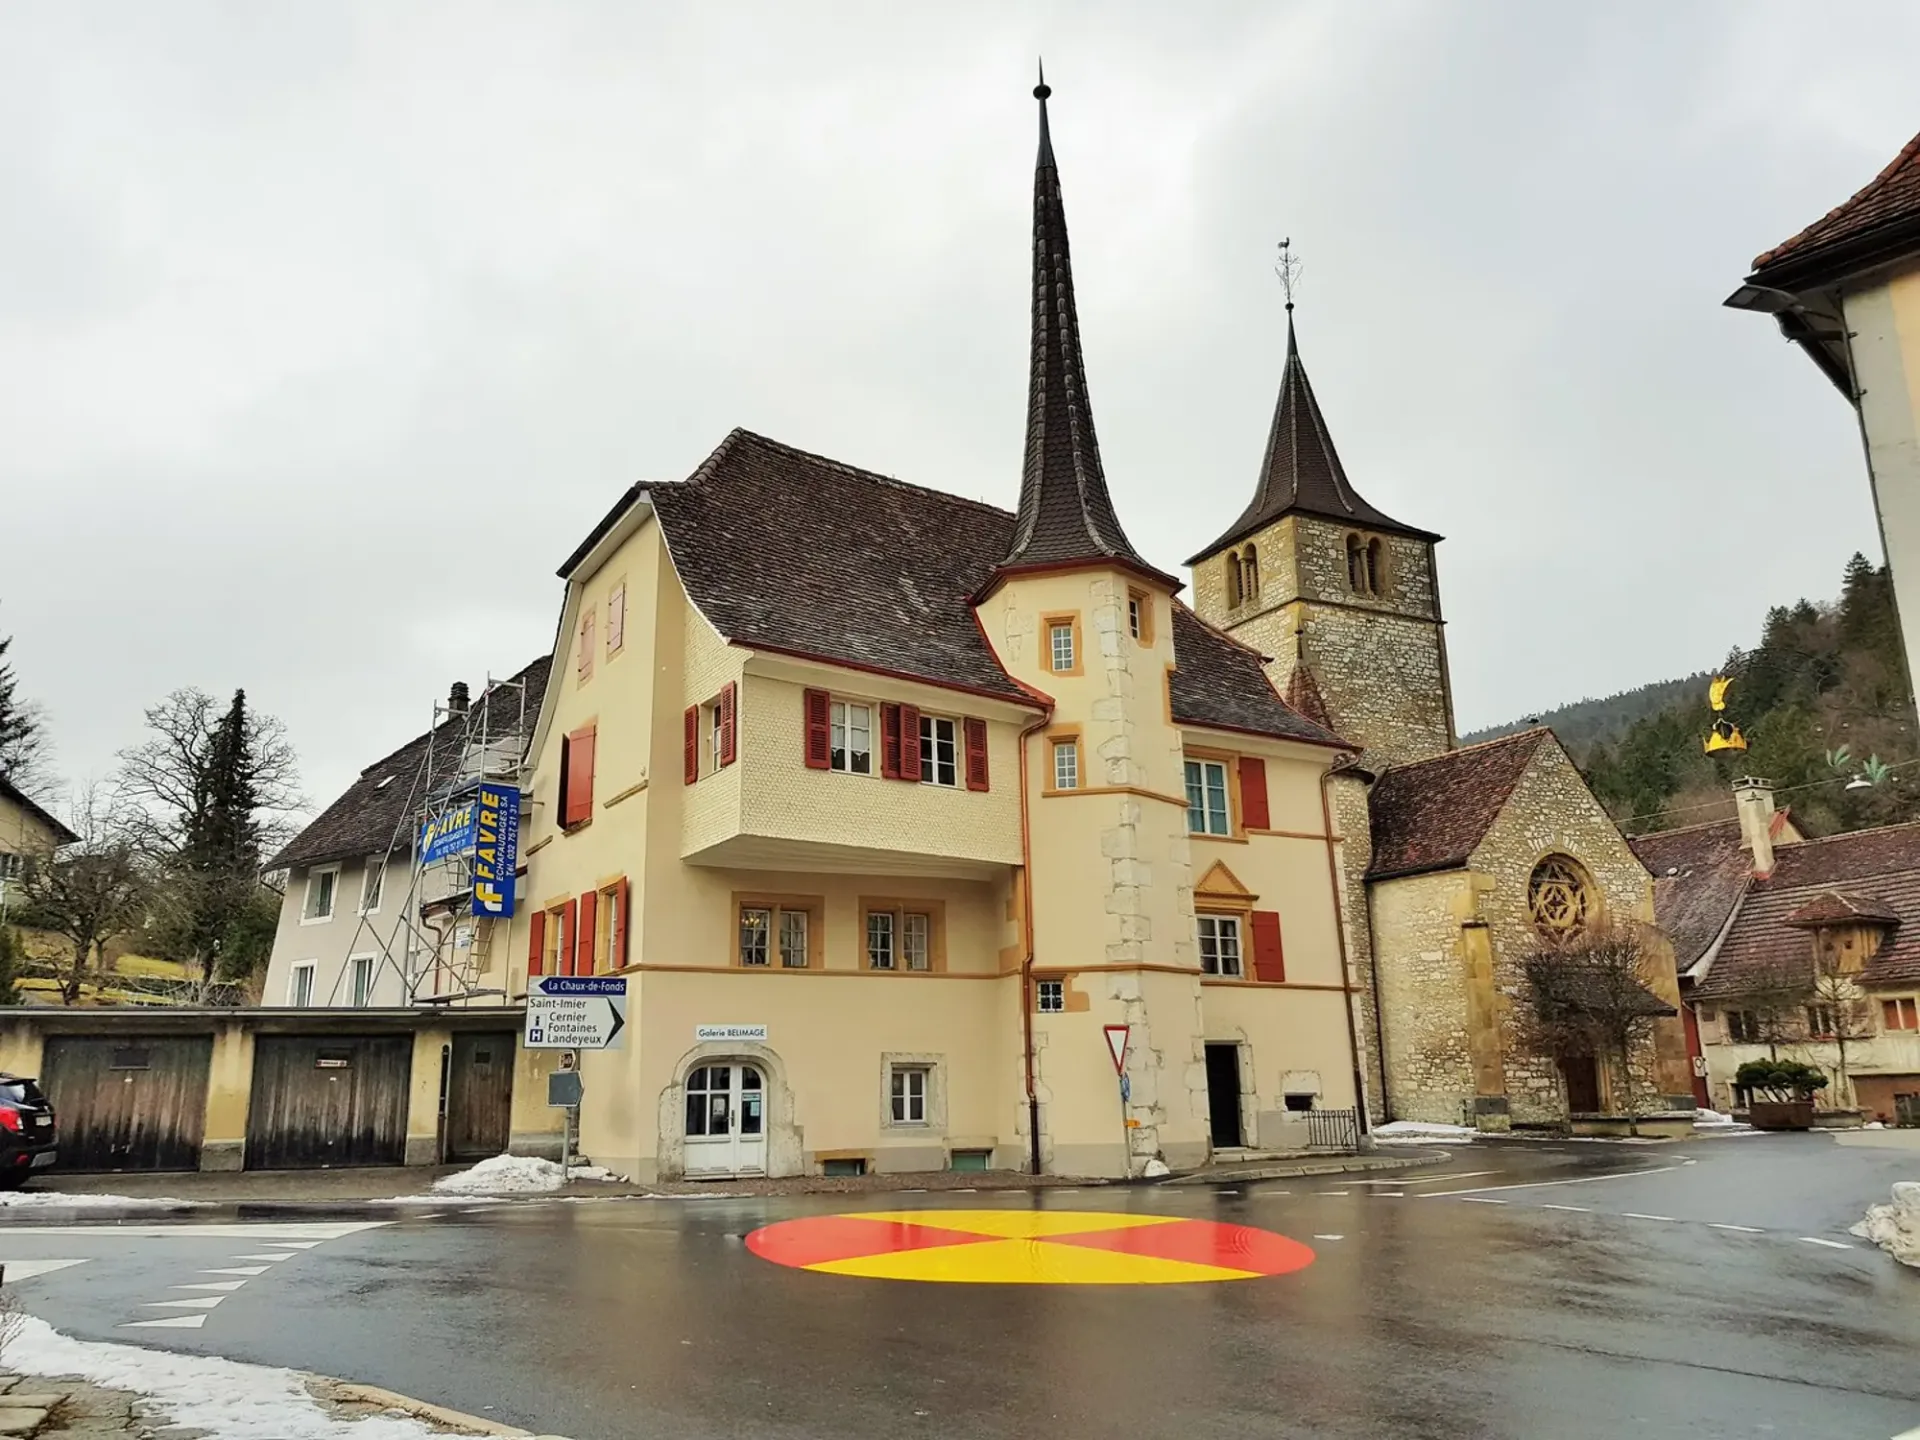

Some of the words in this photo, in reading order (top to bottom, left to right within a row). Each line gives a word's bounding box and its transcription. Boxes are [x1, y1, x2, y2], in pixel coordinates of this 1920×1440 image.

[500, 796, 508, 808] SA
[510, 804, 518, 815] 31
[509, 816, 517, 826] 21
[477, 791, 499, 880] FAVRE
[496, 810, 508, 882] ECHAFAUDAGES
[507, 845, 516, 860] 032
[548, 981, 558, 990] La
[560, 981, 625, 991] Chaux-de-Fonds
[530, 998, 587, 1009] Saint-Imier
[549, 1012, 587, 1022] Cernier
[548, 1022, 597, 1033] Fontaines
[699, 1029, 726, 1037] Galerie
[547, 1034, 602, 1046] Landeyeux
